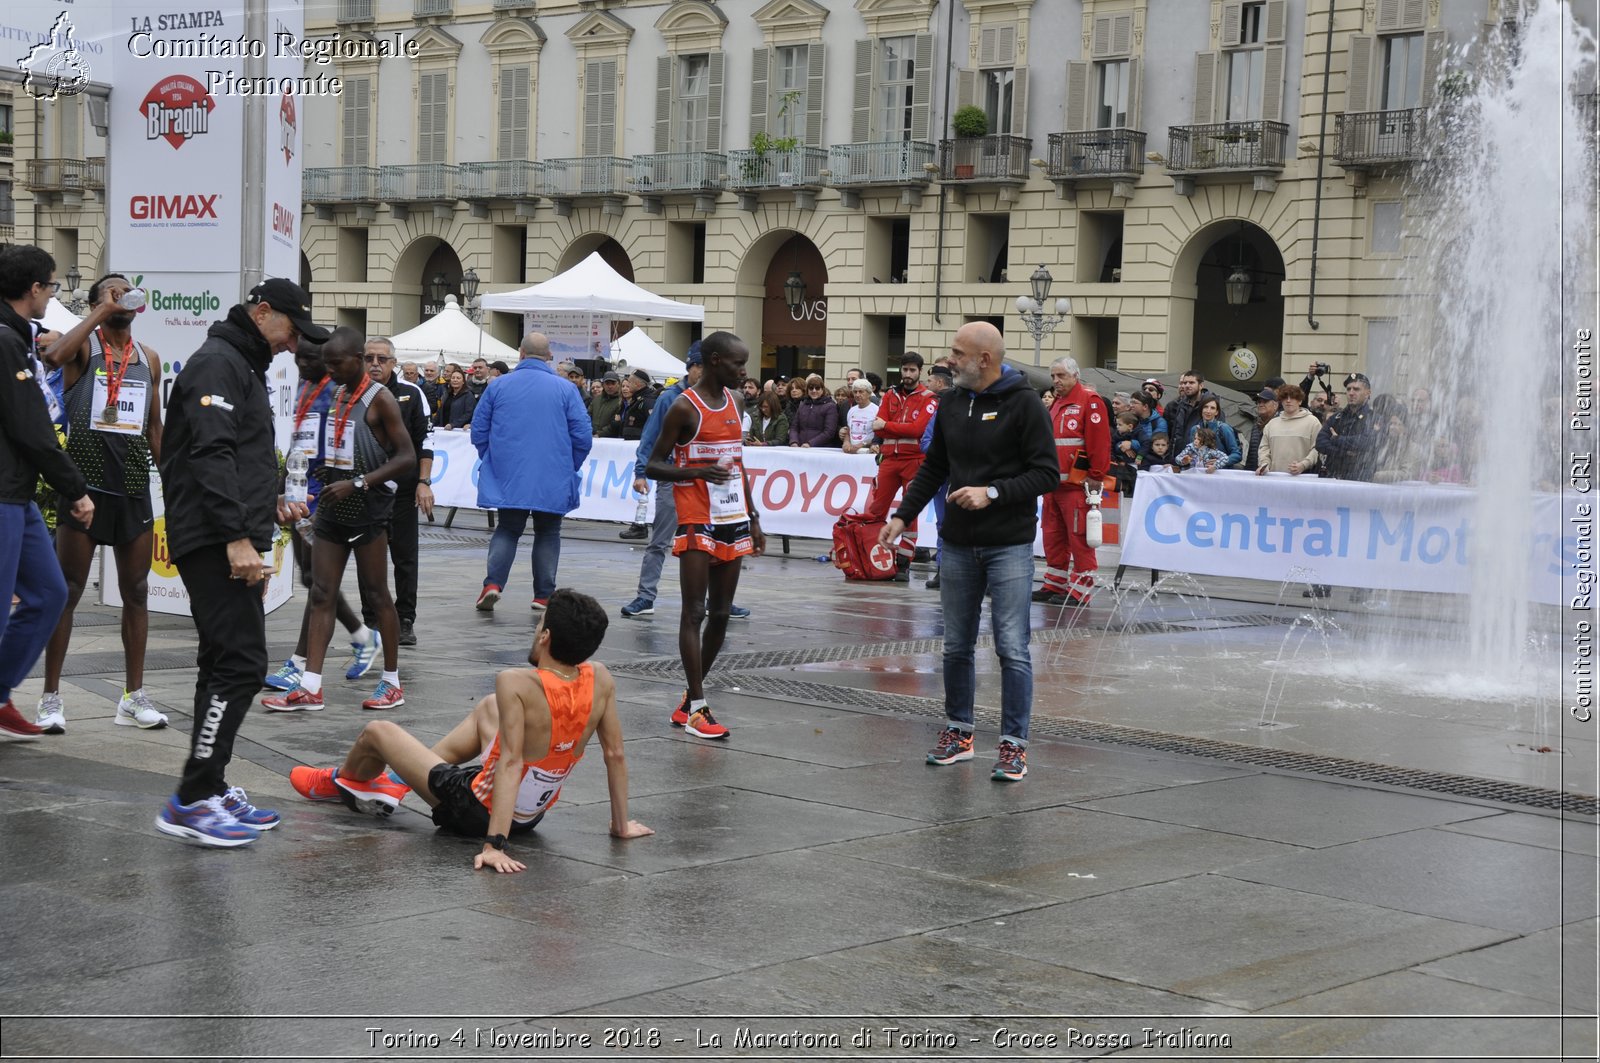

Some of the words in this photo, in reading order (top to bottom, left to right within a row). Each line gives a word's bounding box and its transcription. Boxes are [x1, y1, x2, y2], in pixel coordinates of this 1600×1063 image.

[131, 16, 153, 33] LA
[158, 10, 224, 31] STAMPA
[0, 26, 31, 42] ITTA'
[57, 33, 103, 55] TORINO
[147, 99, 208, 140] Biraghi
[130, 194, 218, 219] GIMAX
[273, 202, 295, 240] GIMAX
[152, 290, 220, 316] Battaglio
[791, 300, 827, 321] OVS
[745, 469, 902, 516] TOYOT
[1144, 495, 1350, 557] Central
[1367, 509, 1576, 577] Motrs
[148, 586, 167, 597] USTO
[168, 589, 180, 598] alla
